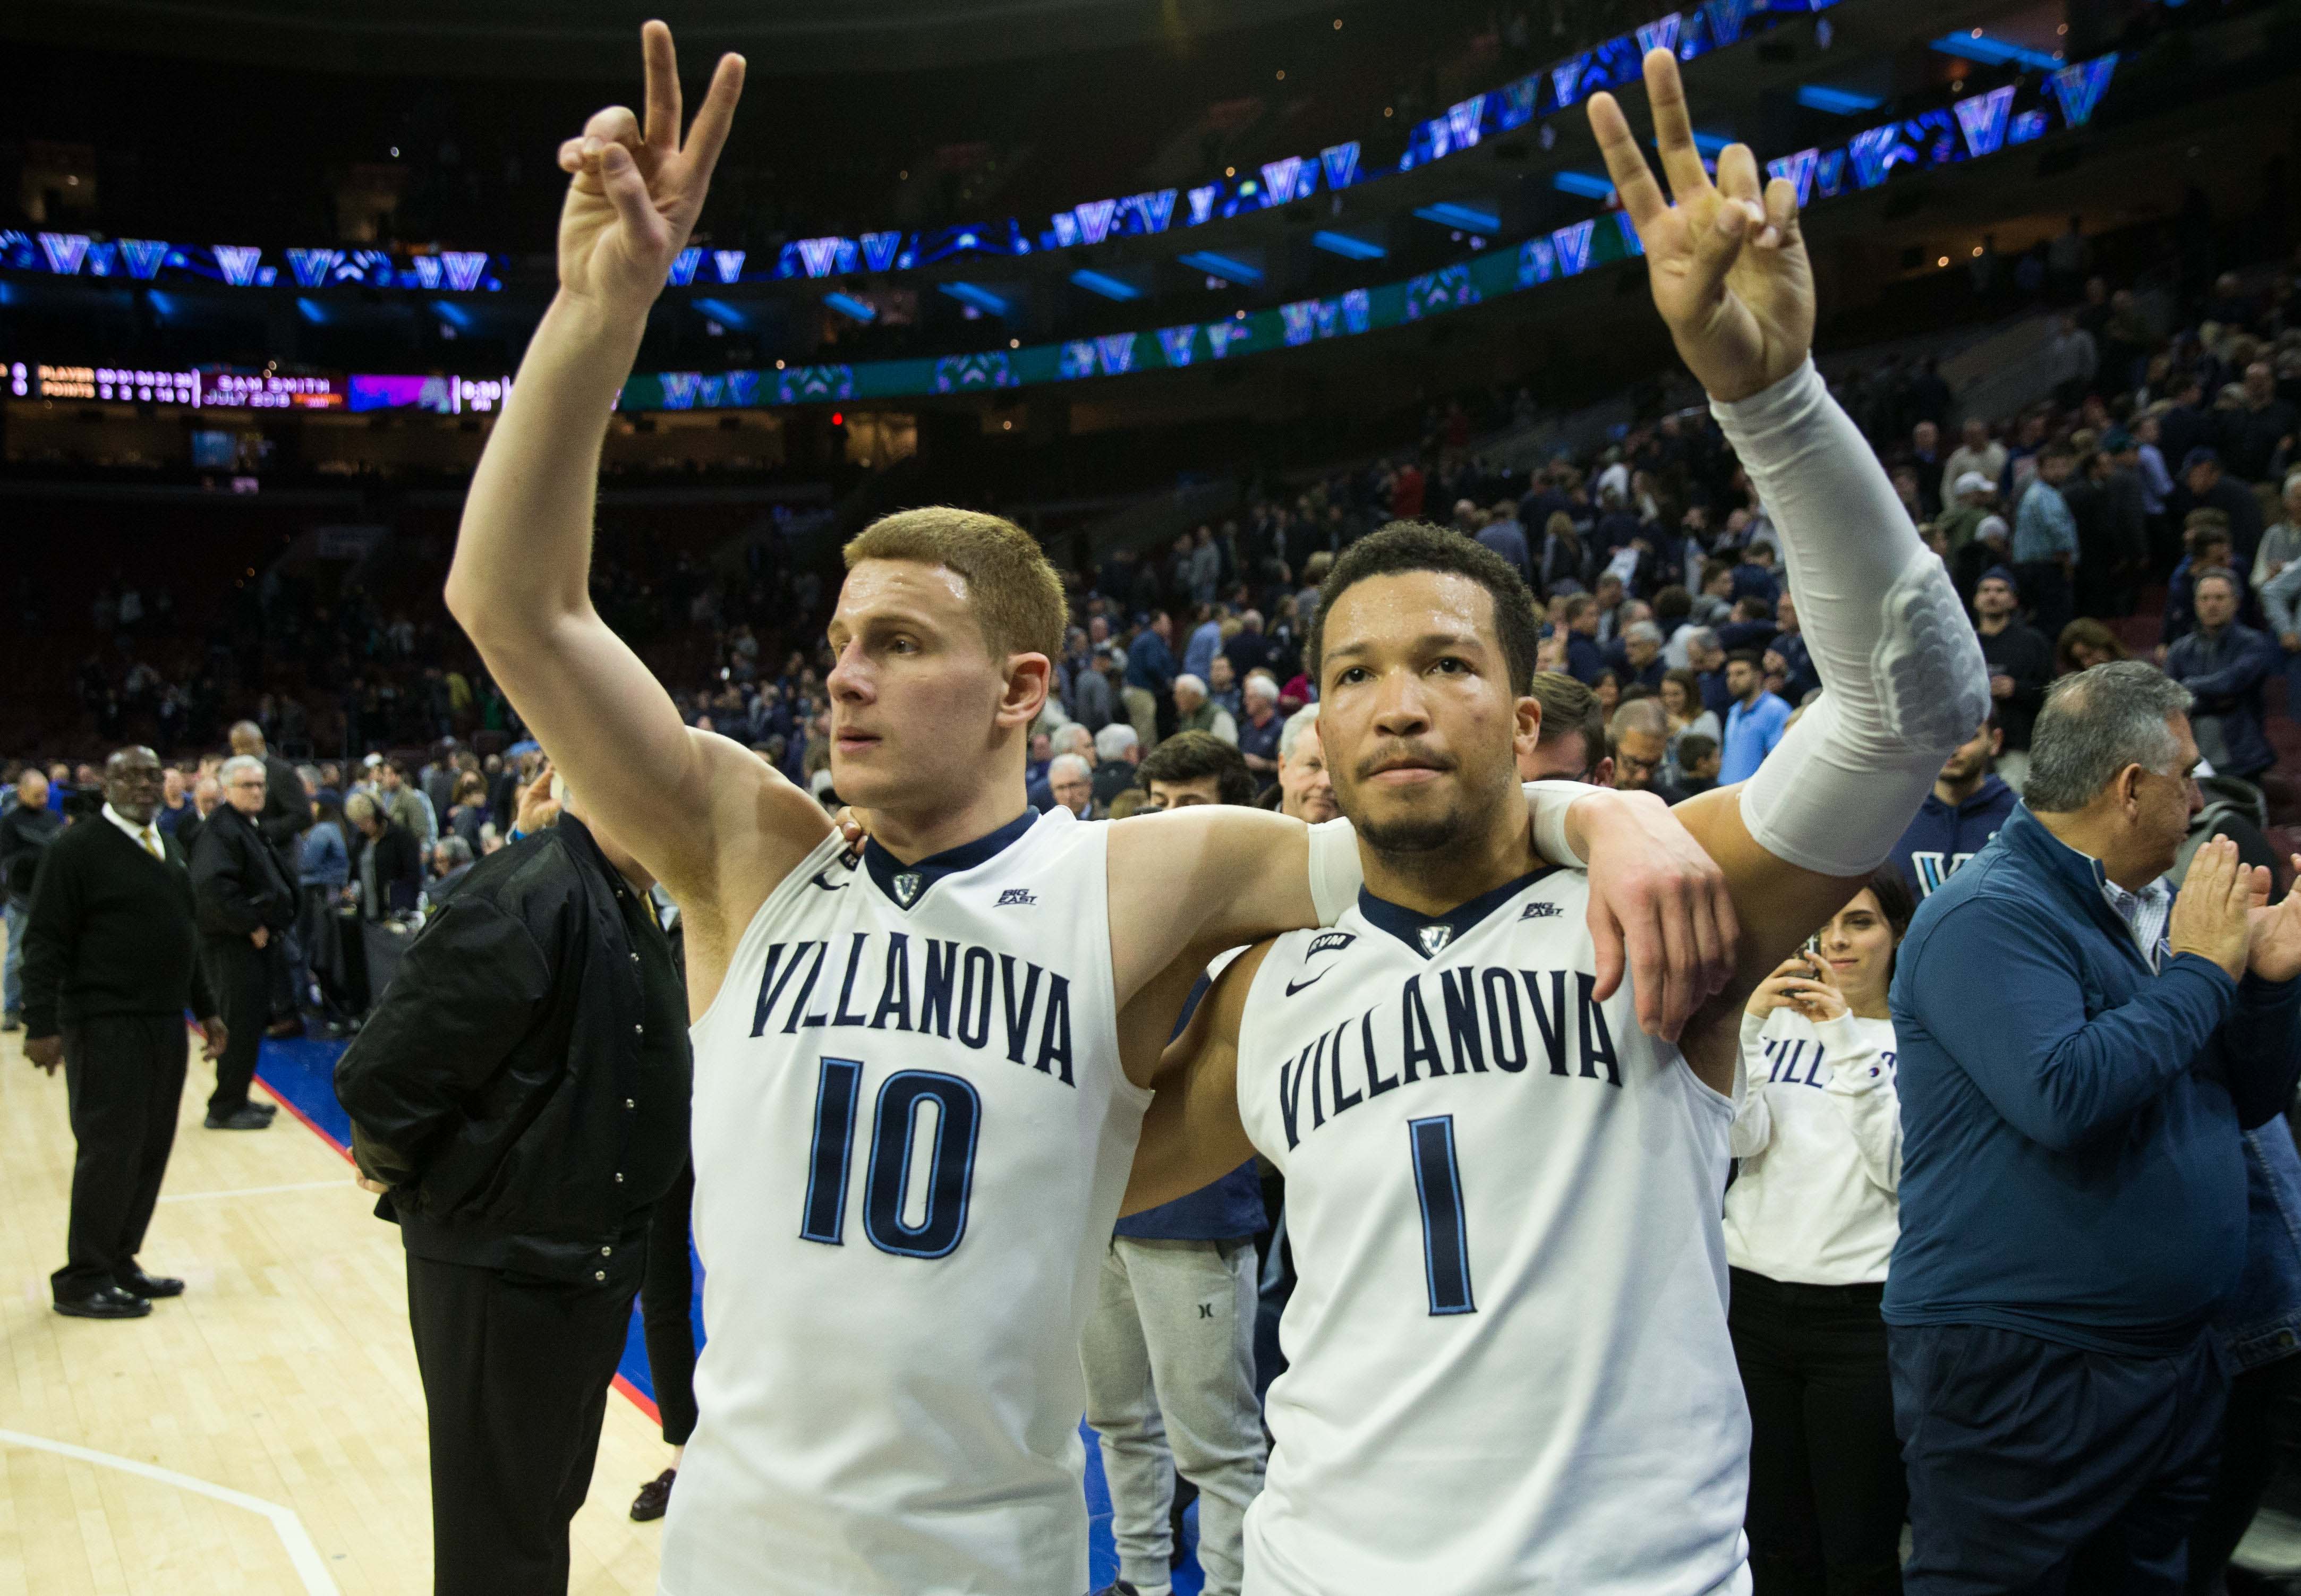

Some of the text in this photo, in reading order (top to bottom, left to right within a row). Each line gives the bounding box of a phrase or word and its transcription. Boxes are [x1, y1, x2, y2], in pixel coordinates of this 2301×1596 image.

[998, 895, 1038, 903] EAST
[1522, 908, 1564, 917] EAST
[749, 931, 1076, 1088] VILANOVA
[1280, 966, 1623, 1153] VILLANOVA
[799, 1056, 982, 1259] 10
[1407, 1114, 1478, 1316] 1
